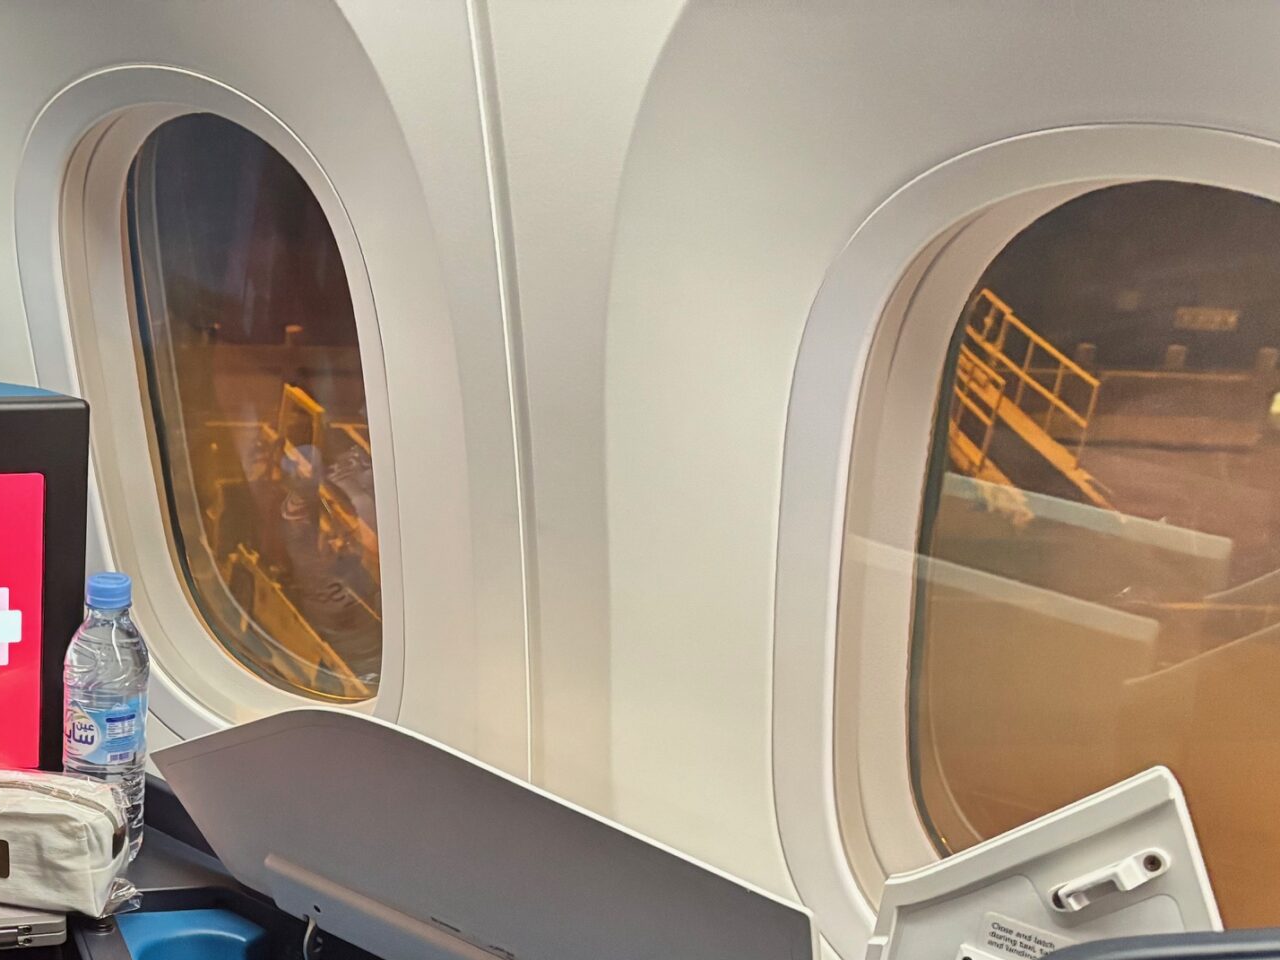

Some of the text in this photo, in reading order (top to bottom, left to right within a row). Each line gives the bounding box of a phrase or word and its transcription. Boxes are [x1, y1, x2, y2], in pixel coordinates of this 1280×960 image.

[76, 721, 95, 733] عين
[991, 922, 1014, 936] Close
[1015, 931, 1032, 942] and
